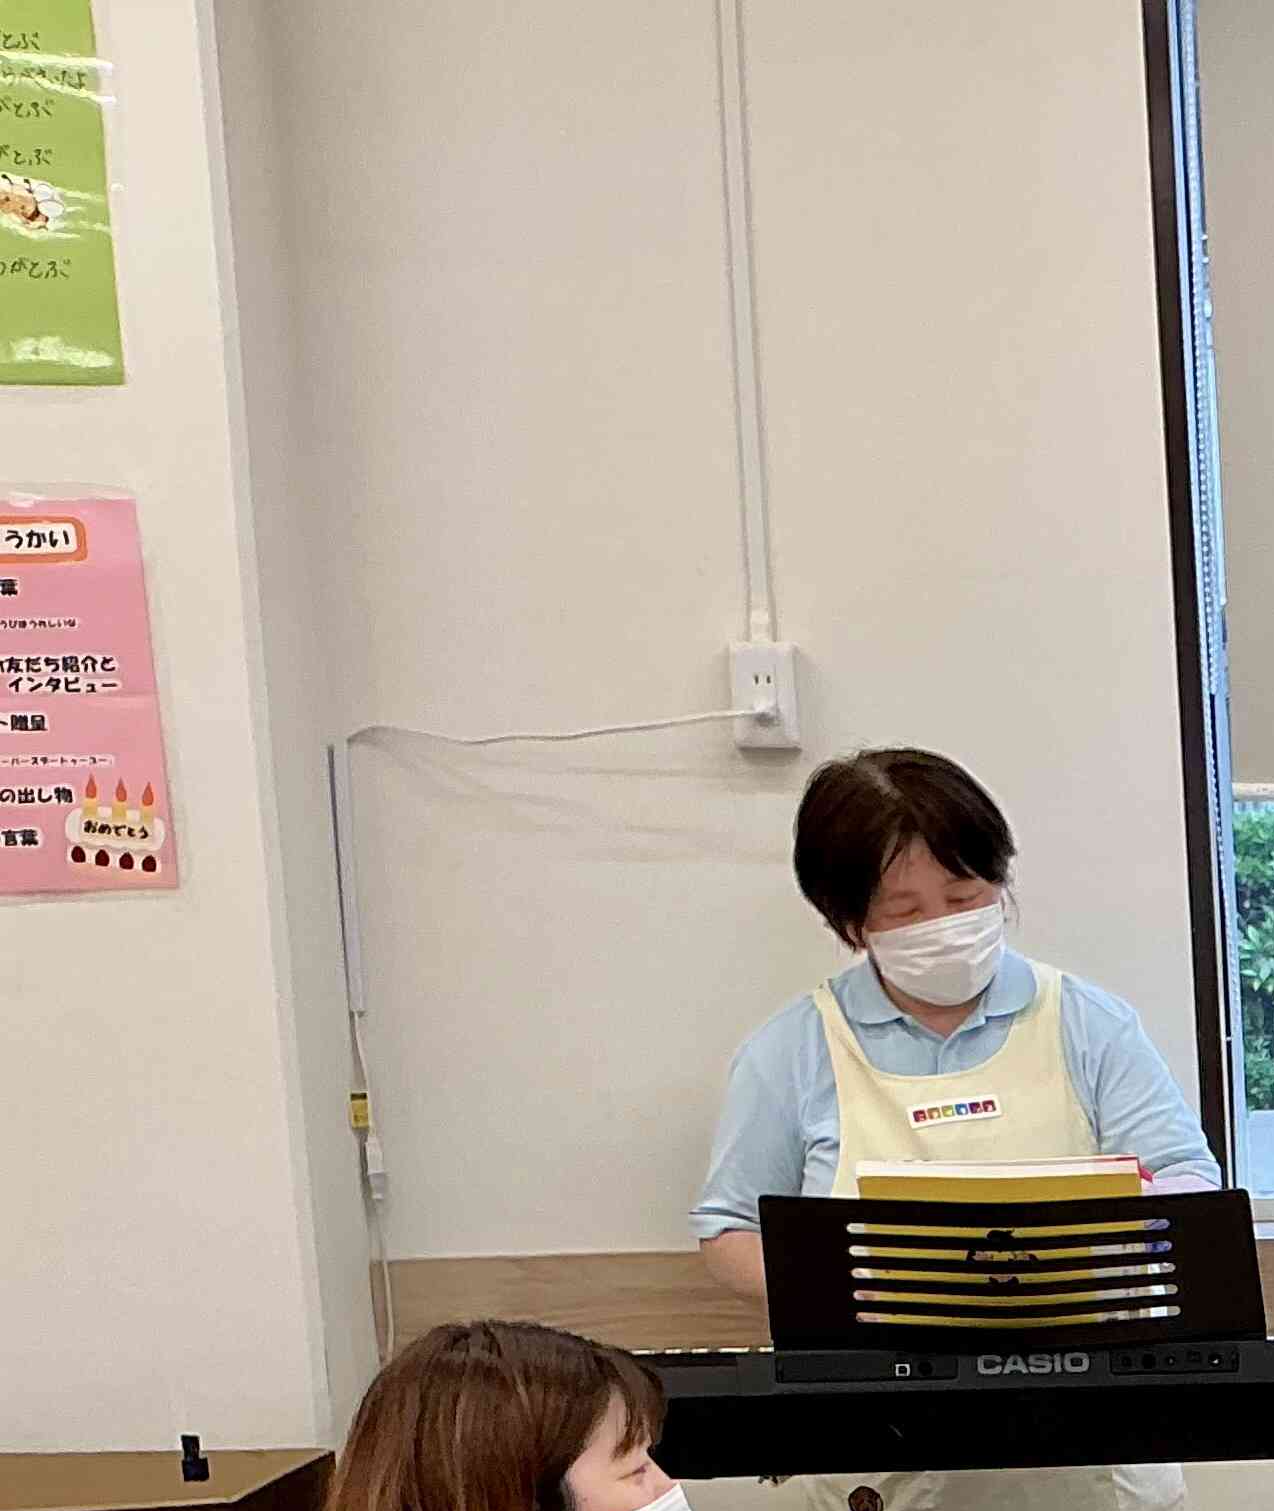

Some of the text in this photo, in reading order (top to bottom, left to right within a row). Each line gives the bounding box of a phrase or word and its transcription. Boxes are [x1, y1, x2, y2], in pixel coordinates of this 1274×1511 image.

[0, 31, 41, 51] とぶ
[4, 529, 70, 549] うかい
[8, 676, 119, 693] インタビュー
[0, 787, 74, 804] の出し物
[83, 820, 149, 840] おめでとう
[976, 1352, 1090, 1375] CASIO
